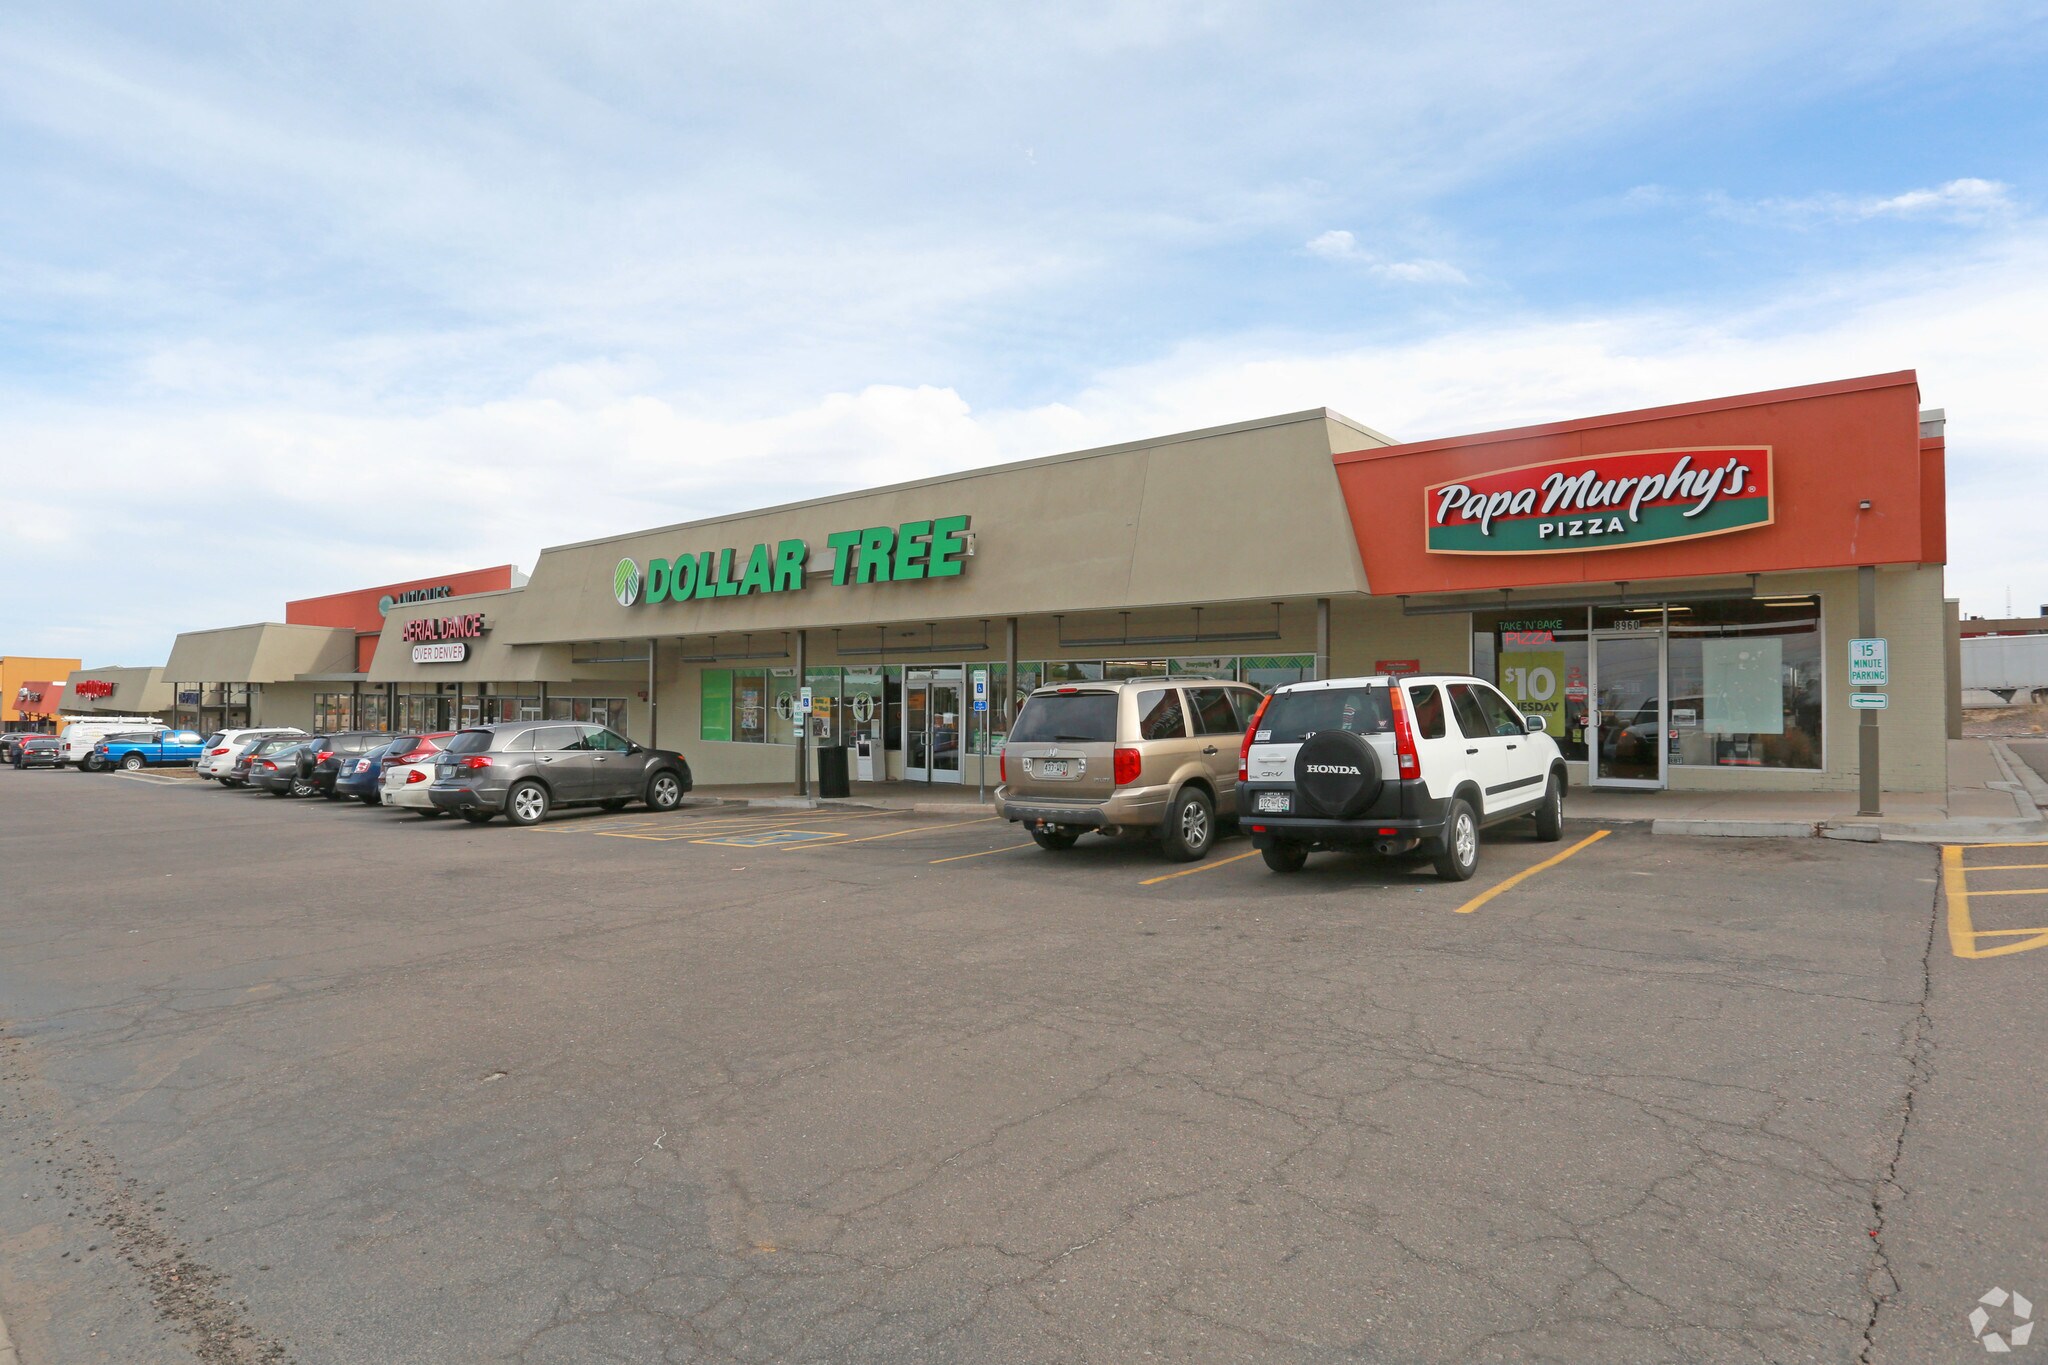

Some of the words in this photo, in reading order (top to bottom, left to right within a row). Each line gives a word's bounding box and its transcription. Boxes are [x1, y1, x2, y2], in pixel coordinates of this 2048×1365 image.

[1436, 484, 1536, 536] Papa
[1541, 455, 1749, 523] Murphy's
[1539, 516, 1625, 539] PIZZA
[645, 538, 807, 605] DOLLAR
[827, 514, 972, 586] TREE
[402, 618, 438, 642] AERIAL
[441, 613, 481, 639] DANCE
[1499, 621, 1521, 631] TAKE
[1537, 619, 1563, 629] BAKE
[1614, 620, 1640, 631] 8960
[1505, 630, 1556, 645] PIZZA
[414, 648, 432, 660] OVER
[434, 645, 463, 659] DENVER
[1861, 644, 1874, 657] 15
[1854, 658, 1882, 668] MINUTE
[1505, 666, 1556, 701] $10
[1852, 671, 1885, 681] PARKING
[1306, 764, 1362, 776] HONDA
